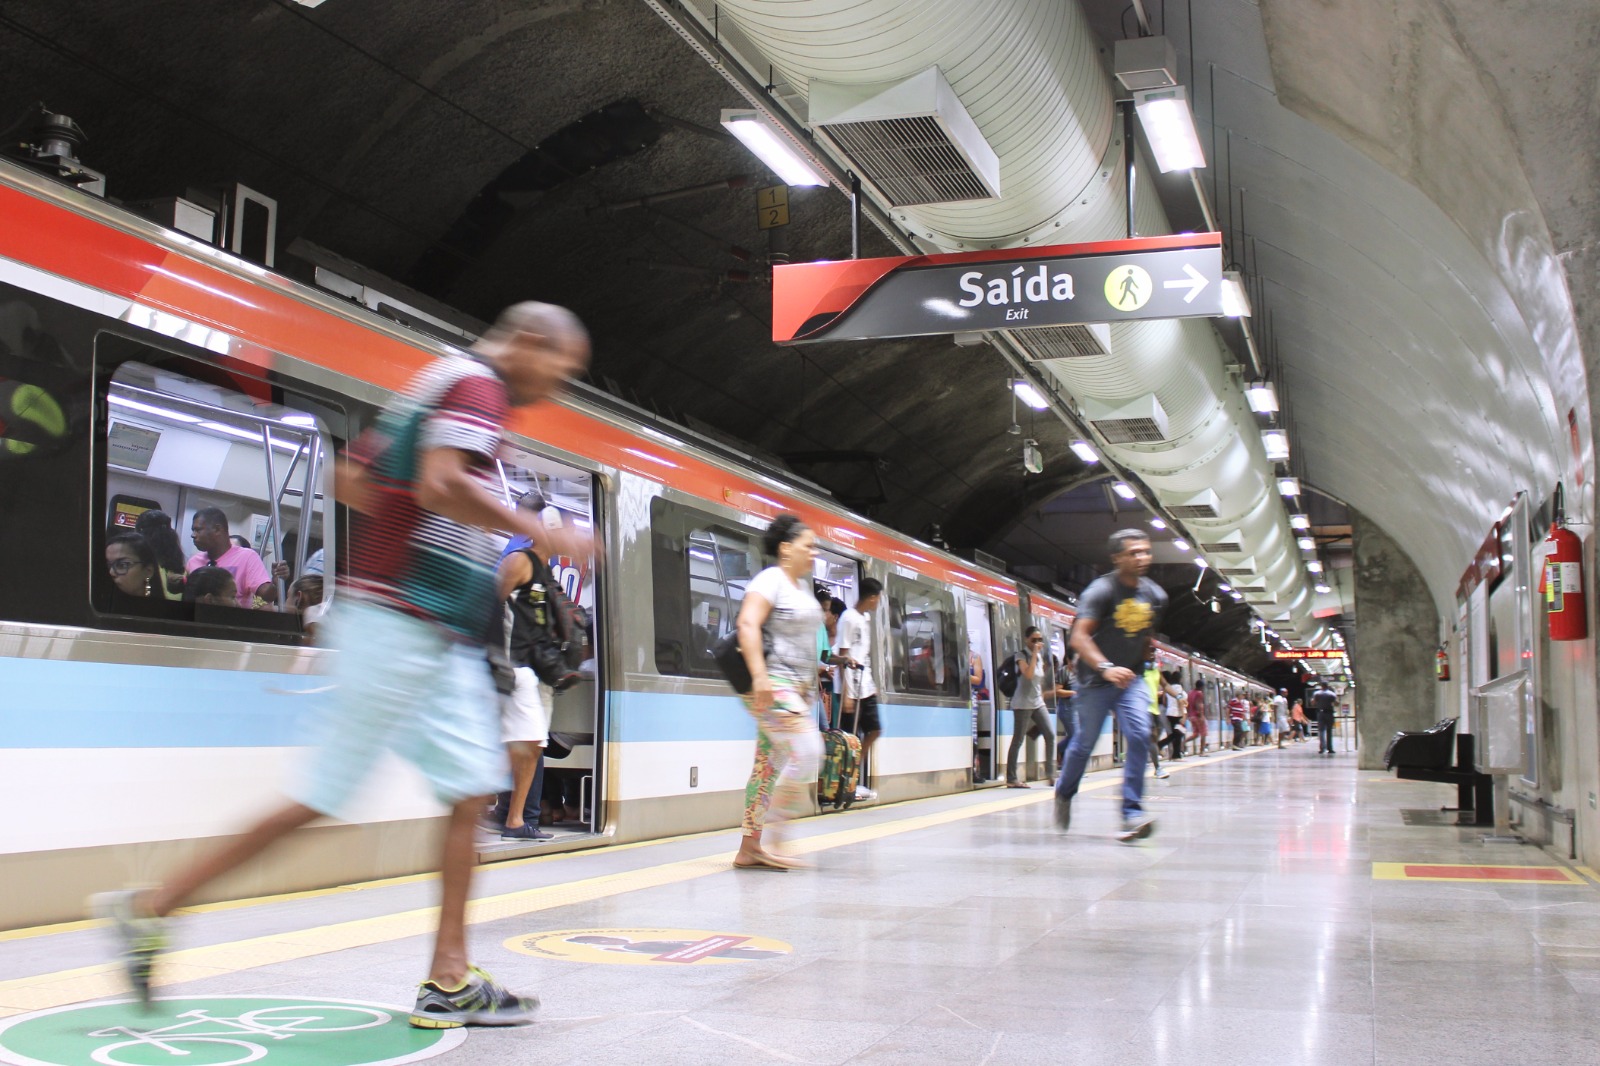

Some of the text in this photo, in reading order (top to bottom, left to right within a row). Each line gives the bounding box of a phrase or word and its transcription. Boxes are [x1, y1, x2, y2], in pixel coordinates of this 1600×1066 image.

[768, 188, 776, 203] 1
[769, 209, 779, 225] 2
[959, 265, 1075, 307] Saída
[1005, 307, 1029, 320] Exit
